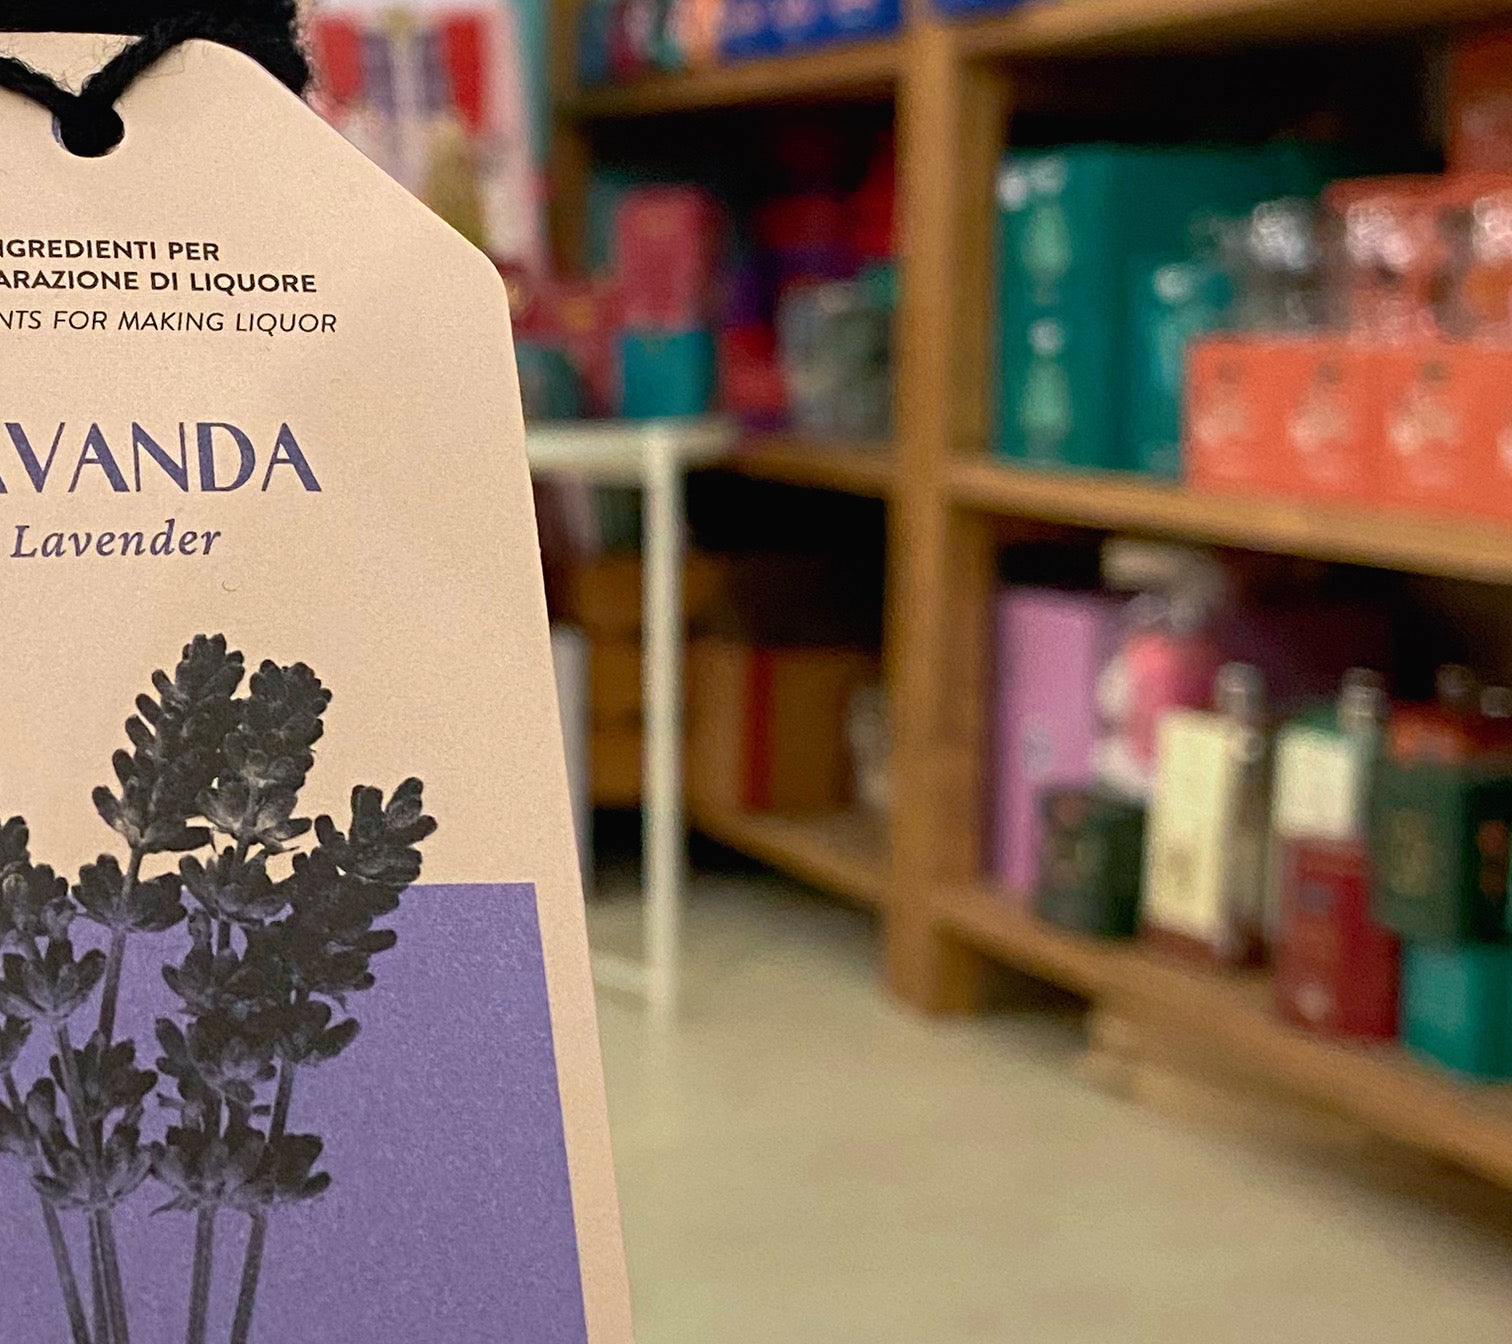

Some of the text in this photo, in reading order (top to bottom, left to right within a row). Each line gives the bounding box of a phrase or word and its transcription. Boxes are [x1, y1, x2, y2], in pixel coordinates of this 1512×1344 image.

[168, 241, 220, 262] PER
[150, 271, 178, 291] DI
[190, 272, 317, 297] LIQUORE
[53, 310, 108, 331] FOR
[117, 310, 225, 332] MAKING
[236, 312, 337, 337] LIQUOR
[9, 518, 222, 558] Lavender
